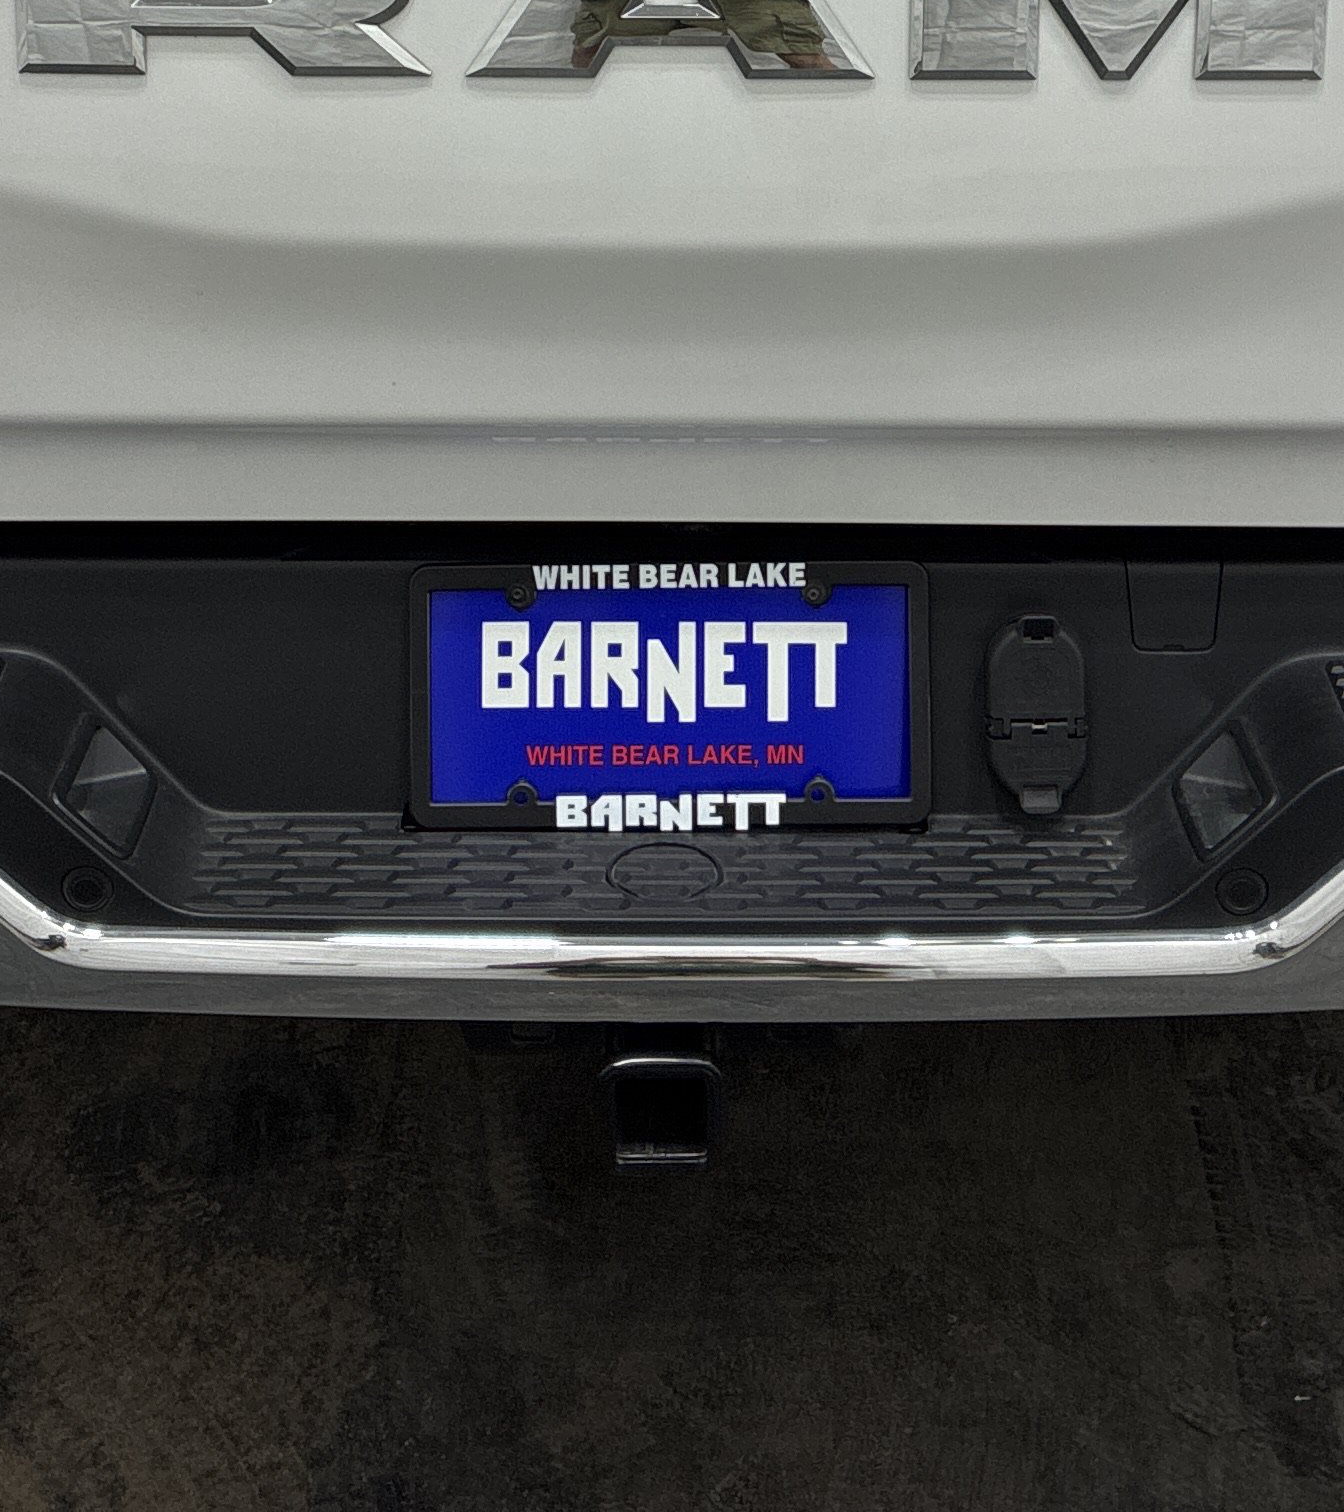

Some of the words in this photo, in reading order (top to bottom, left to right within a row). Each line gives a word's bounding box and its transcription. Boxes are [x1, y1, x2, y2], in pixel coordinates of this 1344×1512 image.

[532, 565, 630, 590] WHITE
[639, 564, 719, 588] BEAR
[727, 563, 807, 588] LAKE
[481, 620, 848, 723] BARNETT
[526, 745, 604, 767] WHITE
[612, 745, 679, 766] BEAR
[687, 744, 760, 768] LAKE,
[767, 744, 805, 765] MN
[555, 793, 787, 832] BARNETT
